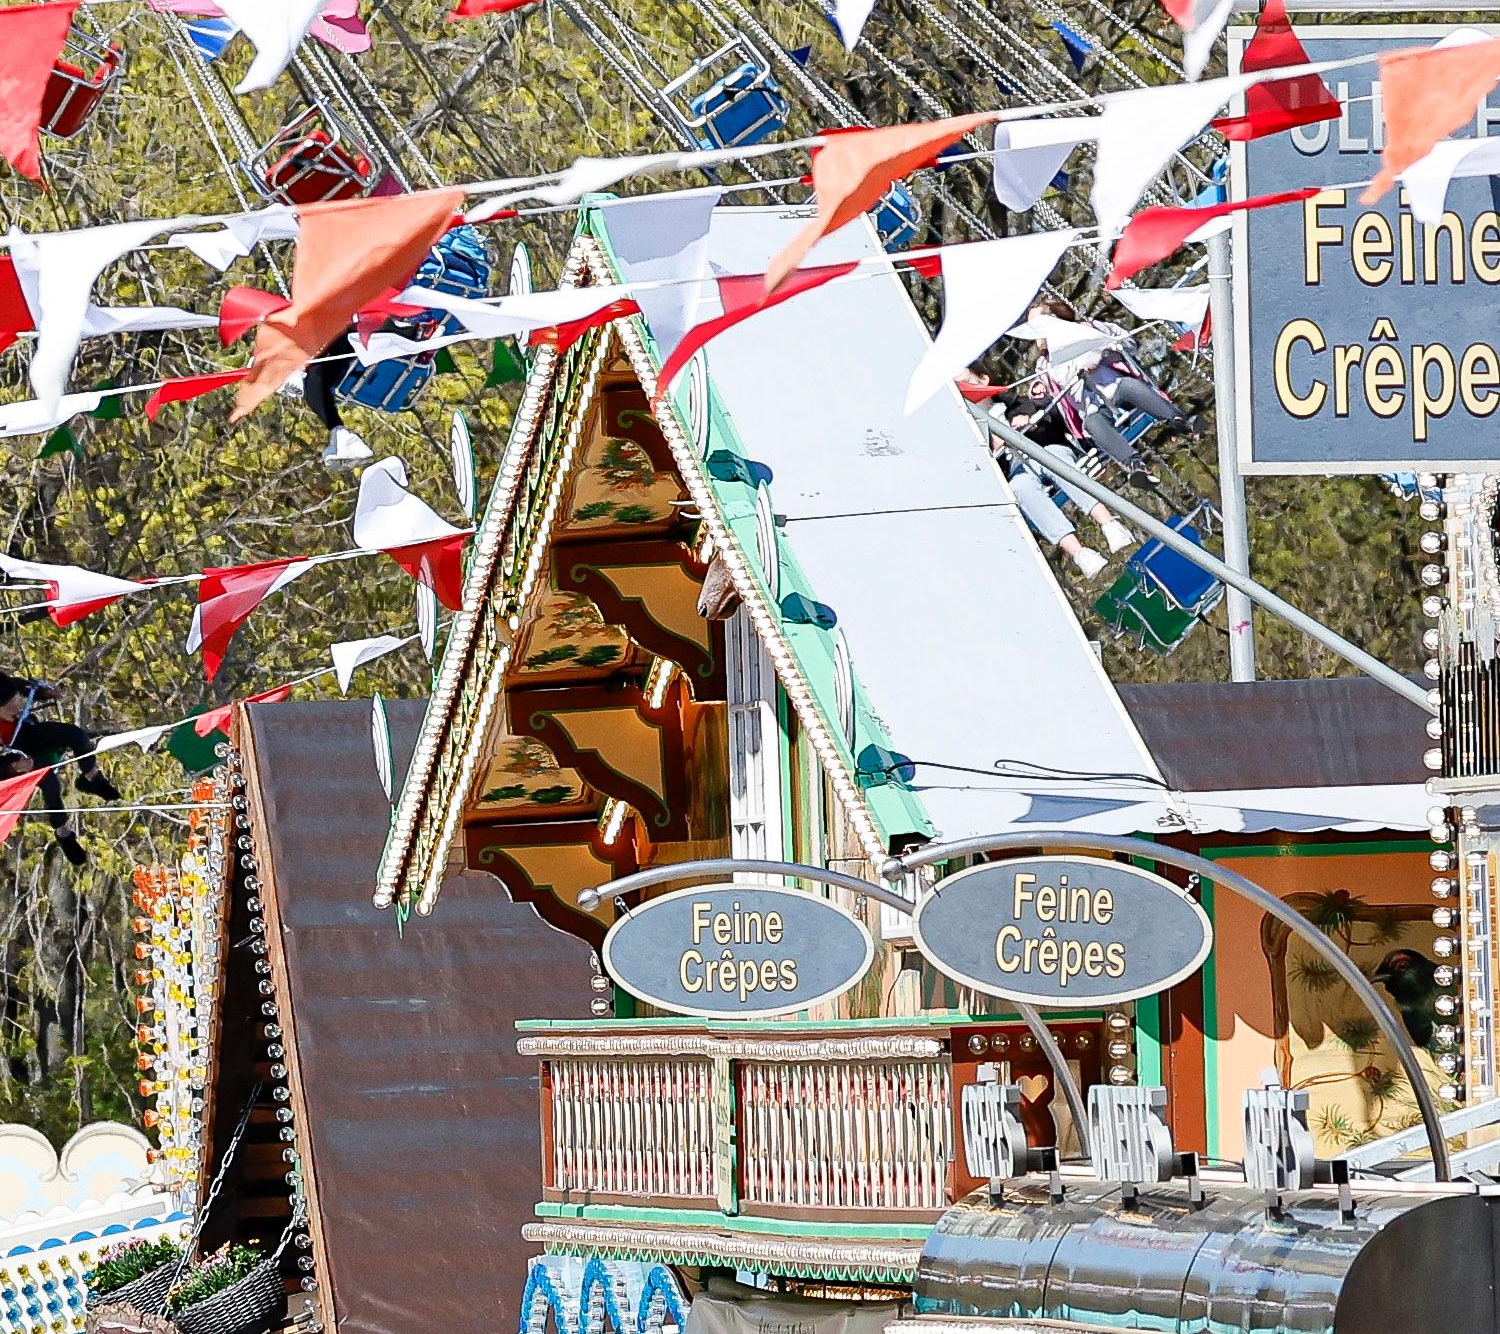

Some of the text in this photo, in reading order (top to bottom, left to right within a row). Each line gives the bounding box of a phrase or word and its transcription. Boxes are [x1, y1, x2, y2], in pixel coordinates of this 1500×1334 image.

[691, 903, 783, 946] Feine
[1013, 874, 1114, 925] Feine
[679, 948, 799, 1002] Crêpes
[996, 927, 1127, 987] Crêpes
